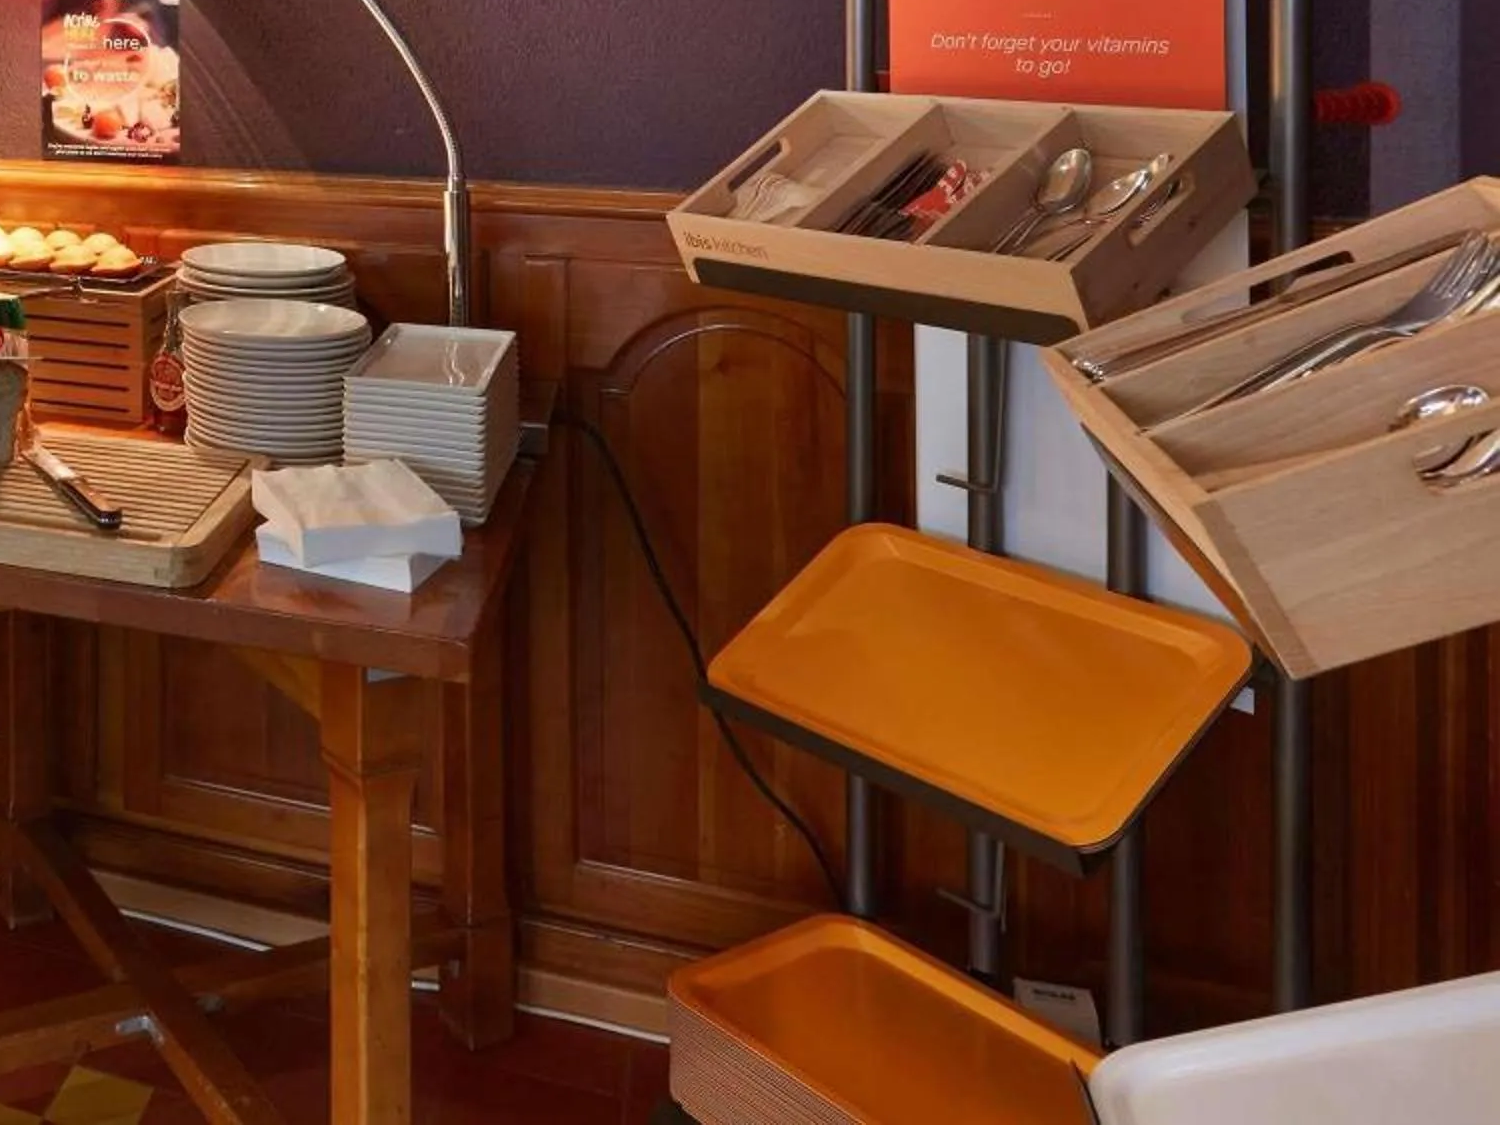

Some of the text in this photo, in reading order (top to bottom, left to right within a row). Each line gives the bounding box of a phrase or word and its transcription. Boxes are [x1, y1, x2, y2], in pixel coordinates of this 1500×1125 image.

[930, 32, 1171, 56] Don't forget your vitamins
[1014, 57, 1073, 79] to go!
